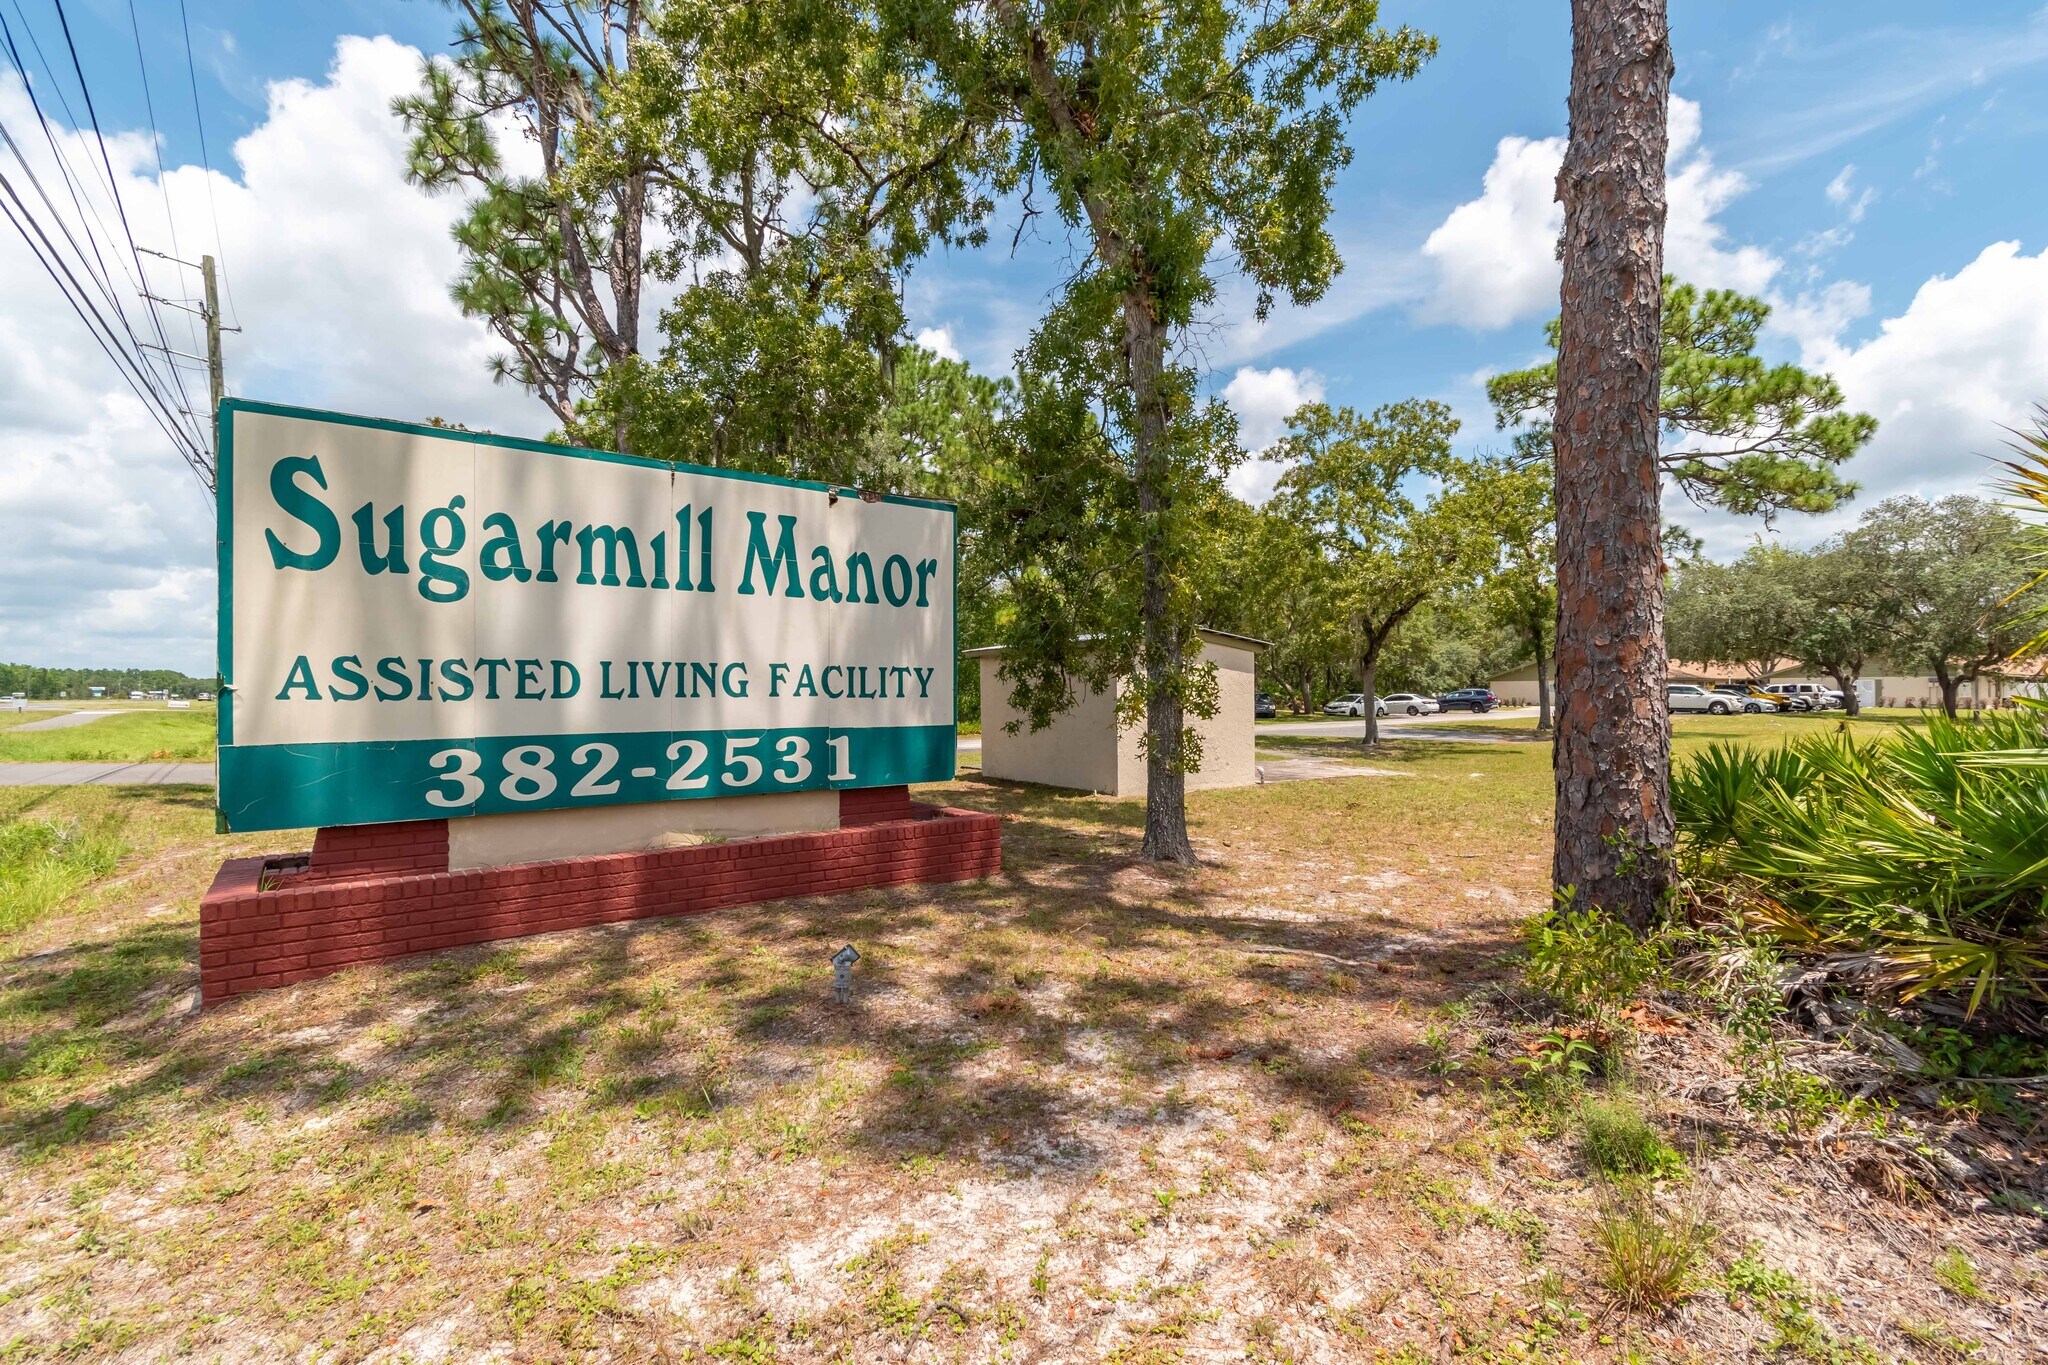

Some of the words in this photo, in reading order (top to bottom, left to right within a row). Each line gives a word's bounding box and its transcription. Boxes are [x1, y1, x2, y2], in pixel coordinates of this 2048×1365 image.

[264, 454, 716, 604] Sugarmill
[737, 510, 938, 608] Manor
[274, 655, 582, 702] ASSISTED
[600, 660, 750, 700] LIVING
[767, 662, 935, 700] FACILITY
[425, 735, 857, 808] 382-2531
